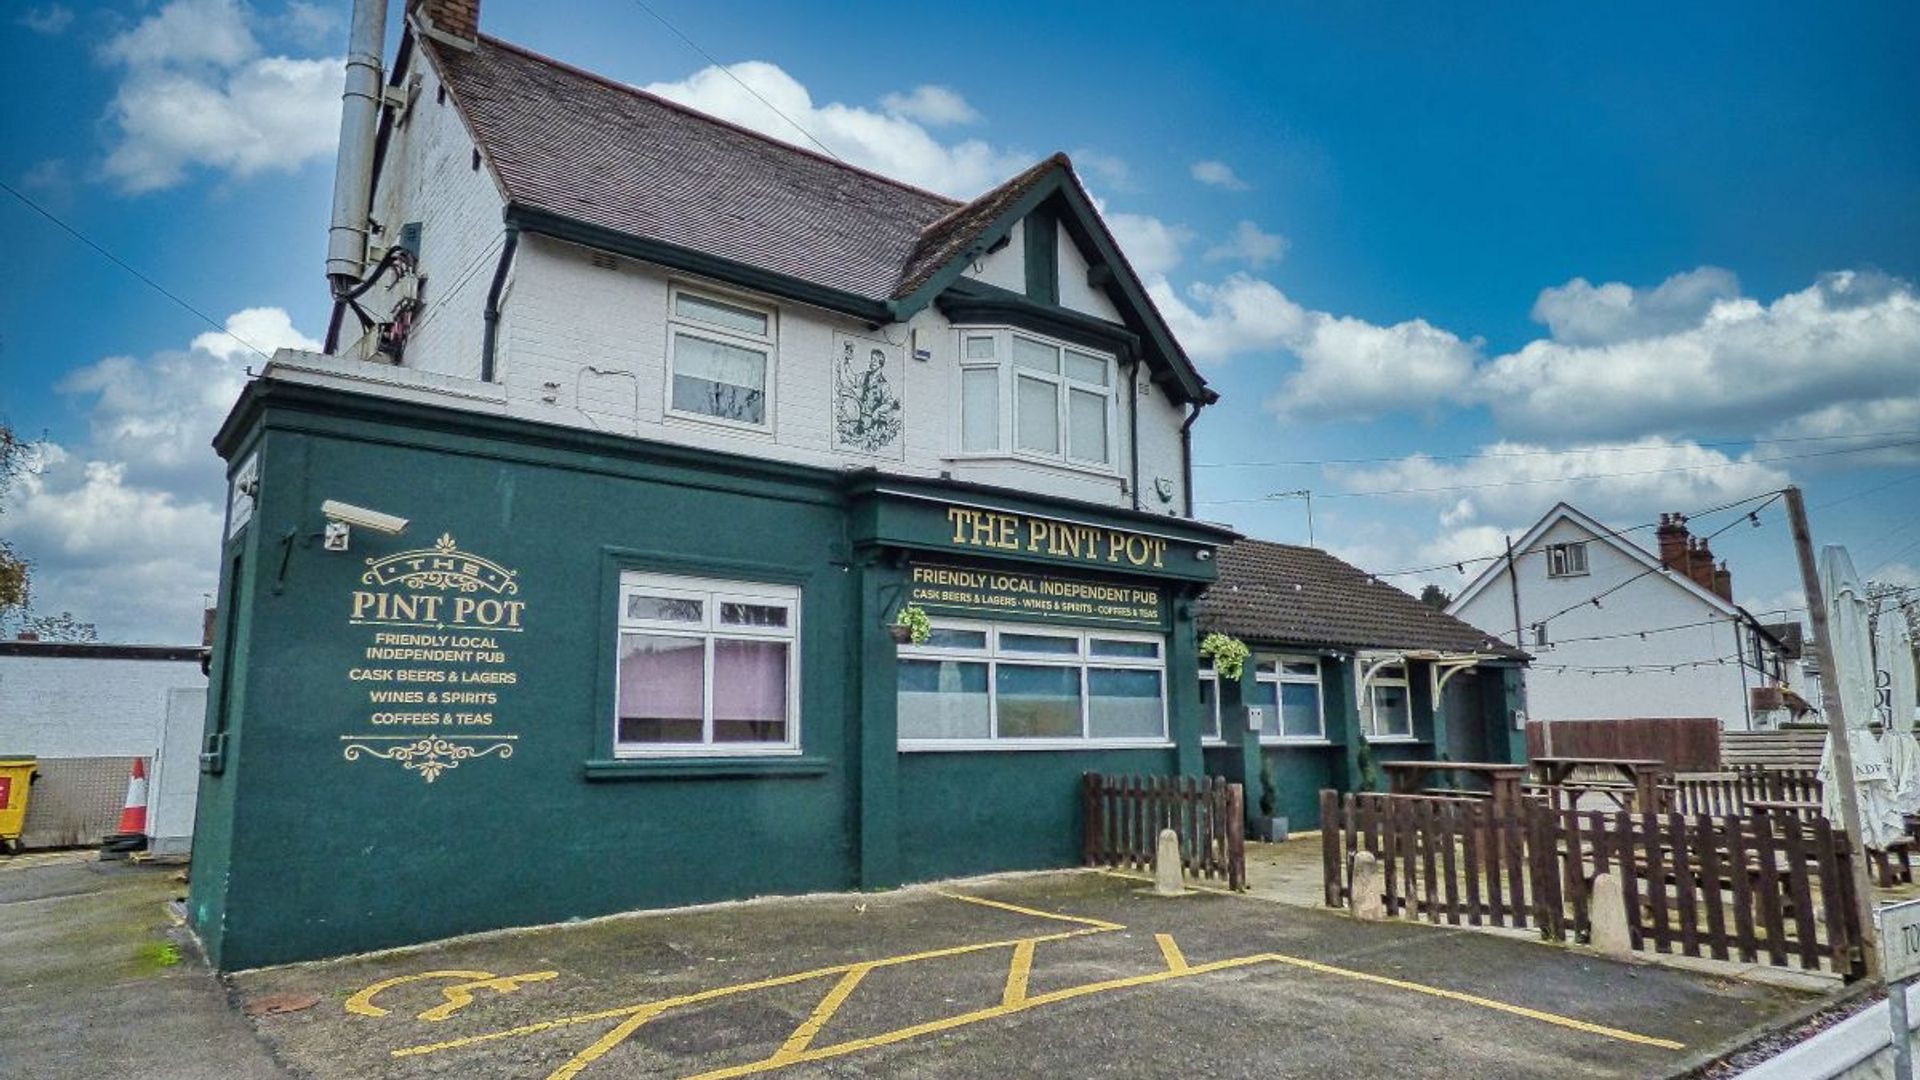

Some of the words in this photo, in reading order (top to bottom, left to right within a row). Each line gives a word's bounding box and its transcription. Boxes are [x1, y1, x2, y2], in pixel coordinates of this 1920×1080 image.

[949, 507, 1019, 550] THE
[1027, 518, 1100, 560] PINT
[1107, 533, 1167, 568] POT
[406, 558, 480, 577] THE
[913, 568, 987, 588] FRIENDLY
[990, 576, 1038, 594] LOCAL
[1040, 581, 1131, 602] INDEPENDENT
[1132, 590, 1158, 605] PUB
[351, 591, 443, 622] PINT
[452, 597, 526, 627] POT
[913, 588, 940, 600] CASK
[942, 591, 972, 603] BEERS
[974, 594, 981, 604] &
[982, 595, 1017, 607] LAGERS
[1022, 599, 1052, 610] WINES
[1054, 601, 1060, 611] &
[1061, 602, 1093, 613] SPIRITS
[1098, 605, 1132, 617] COFFEES
[375, 633, 448, 647] FRIENDLY
[451, 637, 499, 649] LOCAL
[366, 647, 473, 662] INDEPENDENT
[476, 651, 505, 663] PUB
[349, 668, 394, 681] CASK
[396, 669, 445, 682] BEERS
[448, 671, 459, 683] &
[462, 671, 517, 684] LAGERS
[369, 690, 424, 703] WINES
[427, 691, 438, 703] &
[441, 692, 497, 704] SPIRITS
[371, 712, 440, 725] COFFEES
[442, 712, 453, 725] &
[456, 713, 493, 725] TEAS
[1901, 922, 1920, 955] TO
